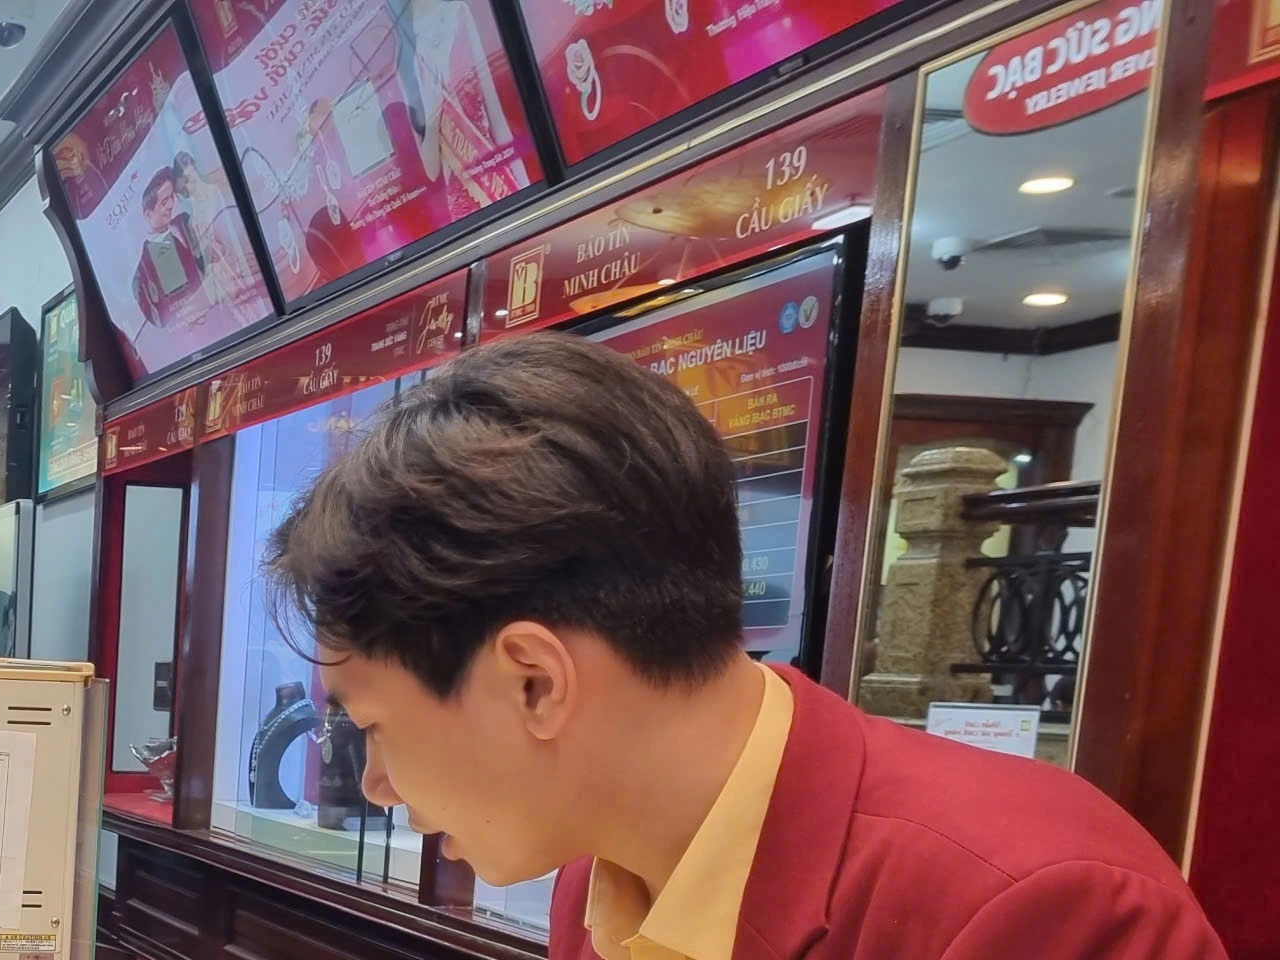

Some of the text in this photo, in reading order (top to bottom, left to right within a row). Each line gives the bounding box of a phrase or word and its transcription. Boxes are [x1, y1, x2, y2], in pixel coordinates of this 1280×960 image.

[764, 145, 808, 190] 139
[735, 174, 829, 239] CẦU GIẤY
[576, 233, 604, 264] BẢO
[562, 251, 641, 299] MINH CHÂU
[314, 342, 332, 367] 139
[650, 329, 767, 377] BẠC NGUYÊN LIỆU
